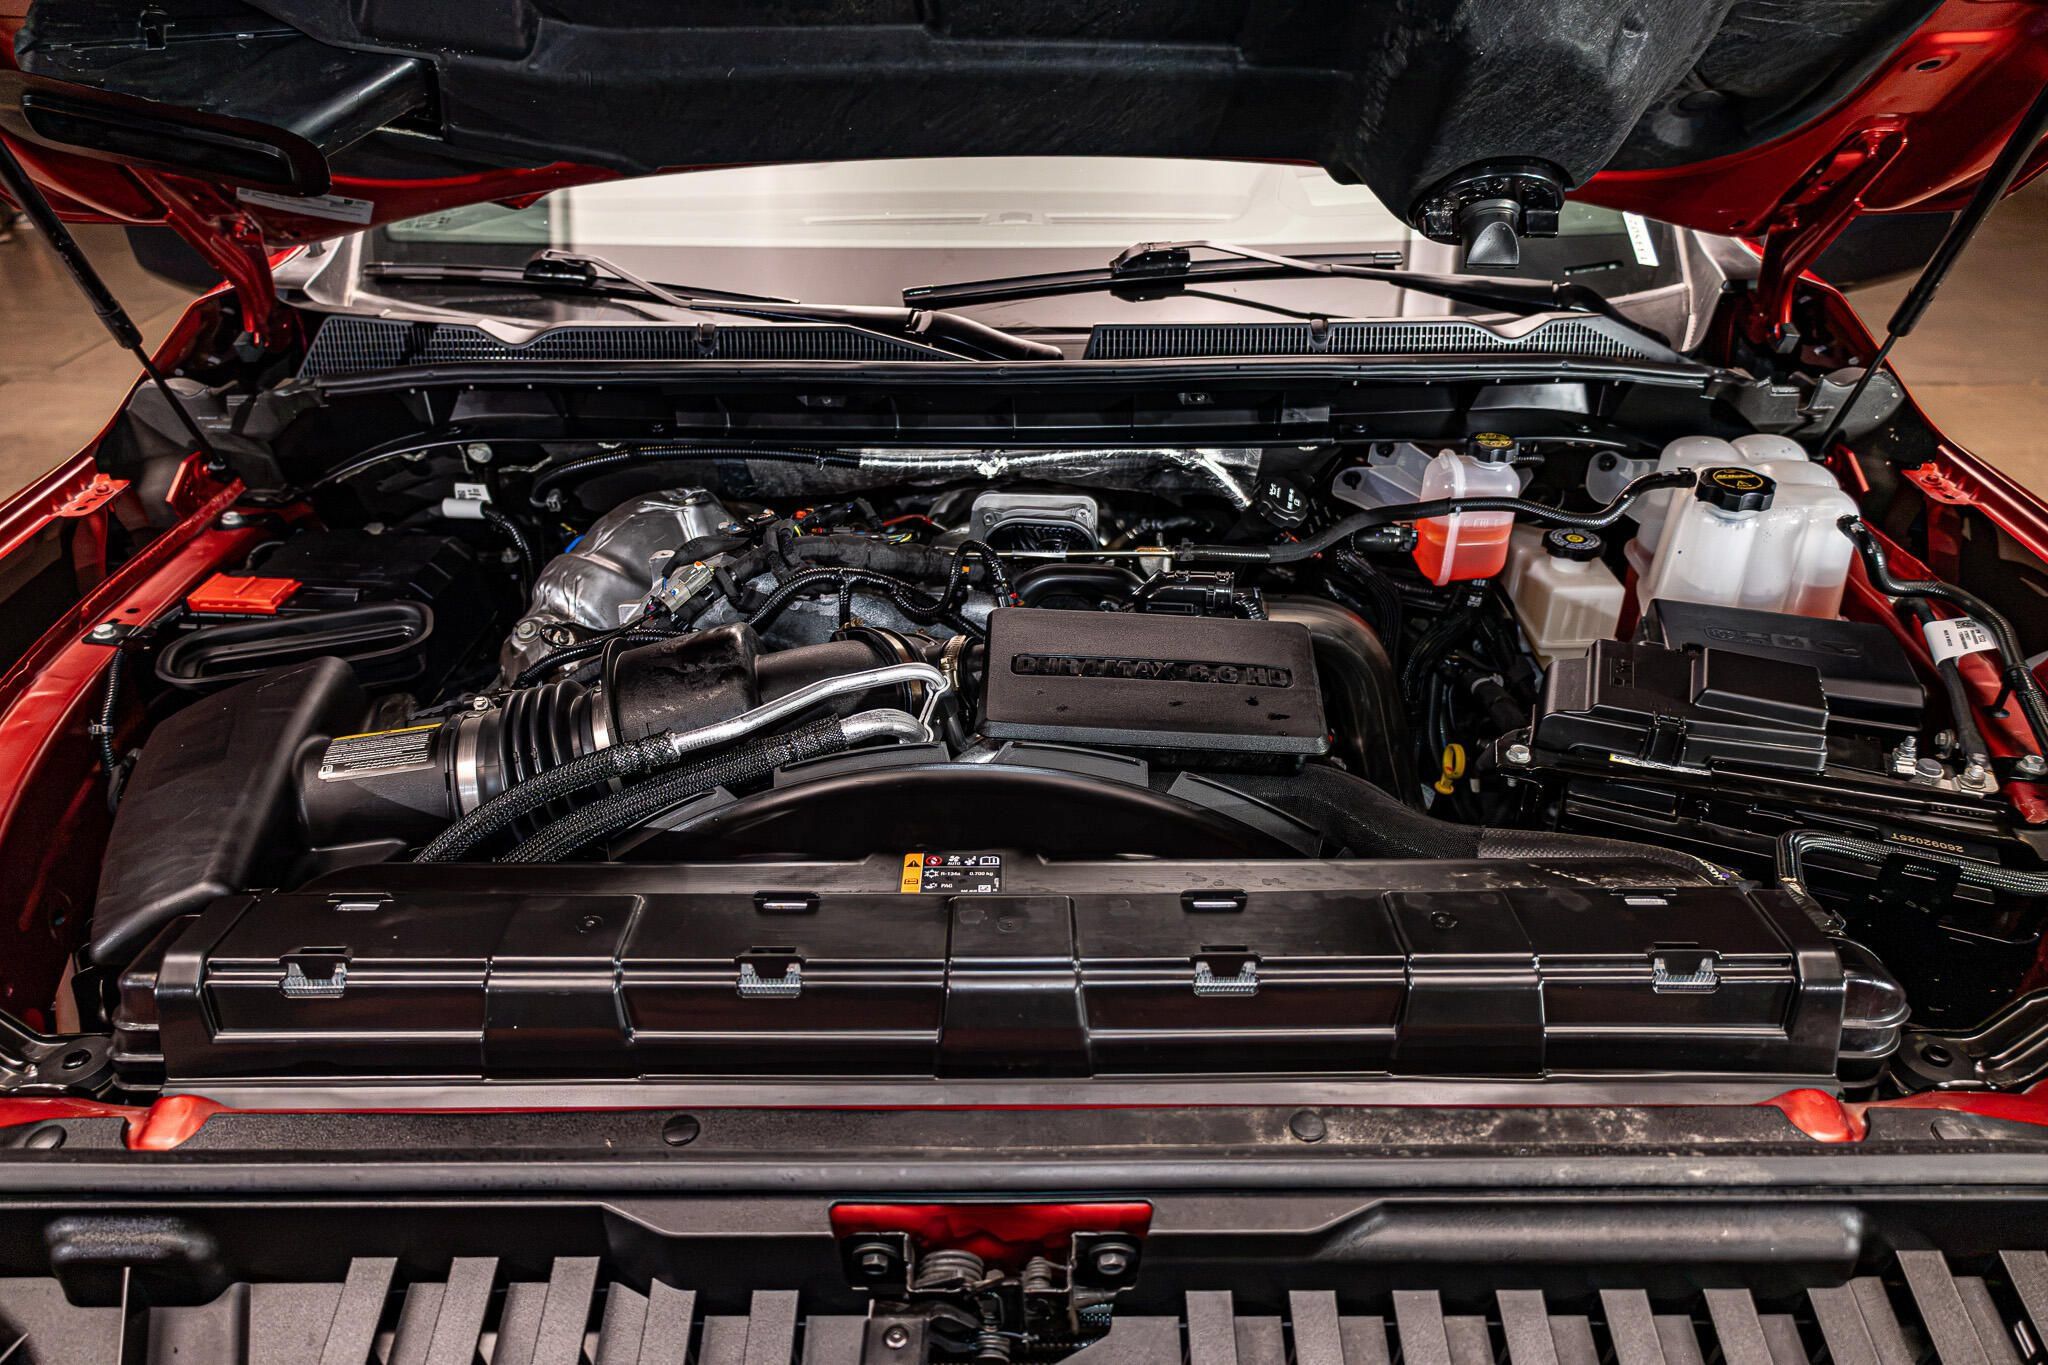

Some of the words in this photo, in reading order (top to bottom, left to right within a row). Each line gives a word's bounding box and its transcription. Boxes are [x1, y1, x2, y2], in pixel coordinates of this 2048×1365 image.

[1015, 655, 1175, 680] DURAMAX
[1189, 663, 1239, 684] 6.6
[1245, 666, 1289, 688] HD
